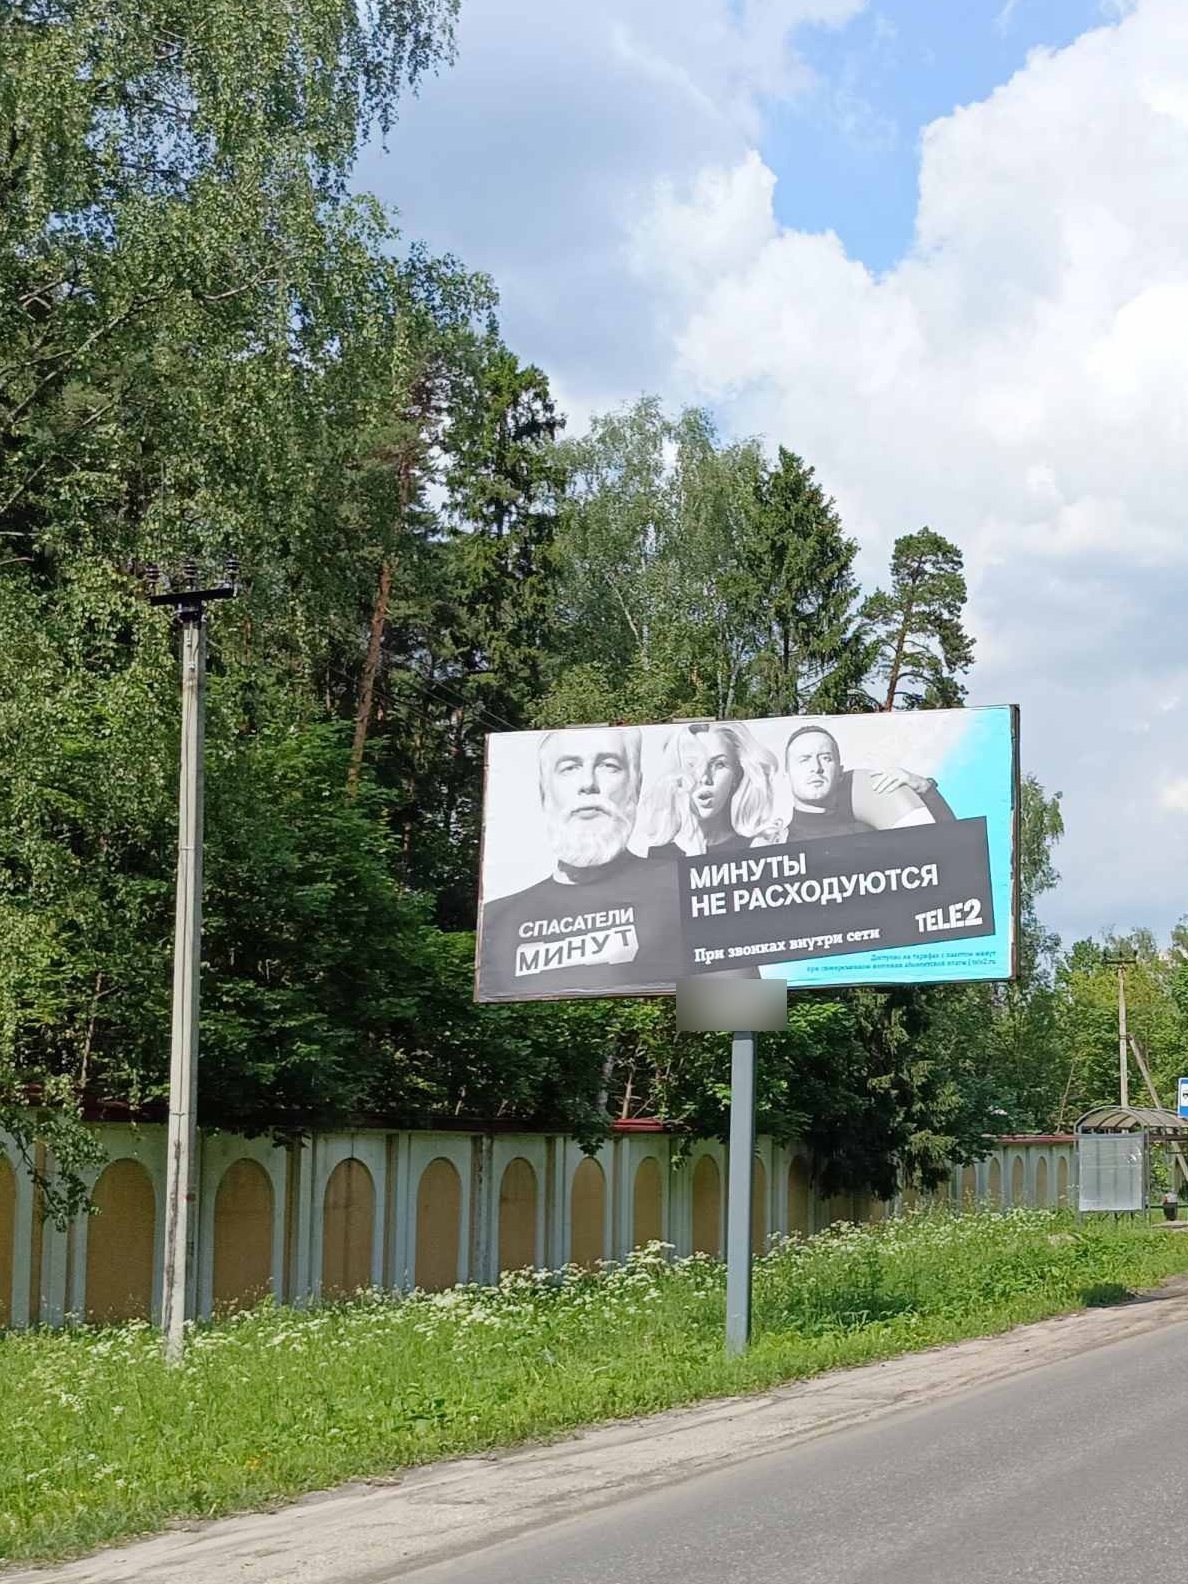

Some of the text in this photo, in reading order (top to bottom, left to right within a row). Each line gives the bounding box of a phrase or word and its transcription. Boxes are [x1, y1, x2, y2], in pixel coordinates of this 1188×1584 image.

[689, 853, 806, 889] МИНУТЫ
[691, 864, 938, 917] НЕ РАСХОДУЮТСЯ
[518, 907, 635, 938] СПАСАТЕЛИ
[915, 898, 983, 933] TELE2
[519, 929, 632, 972] МИНУТ
[694, 927, 880, 965] При звонках внутри сети
